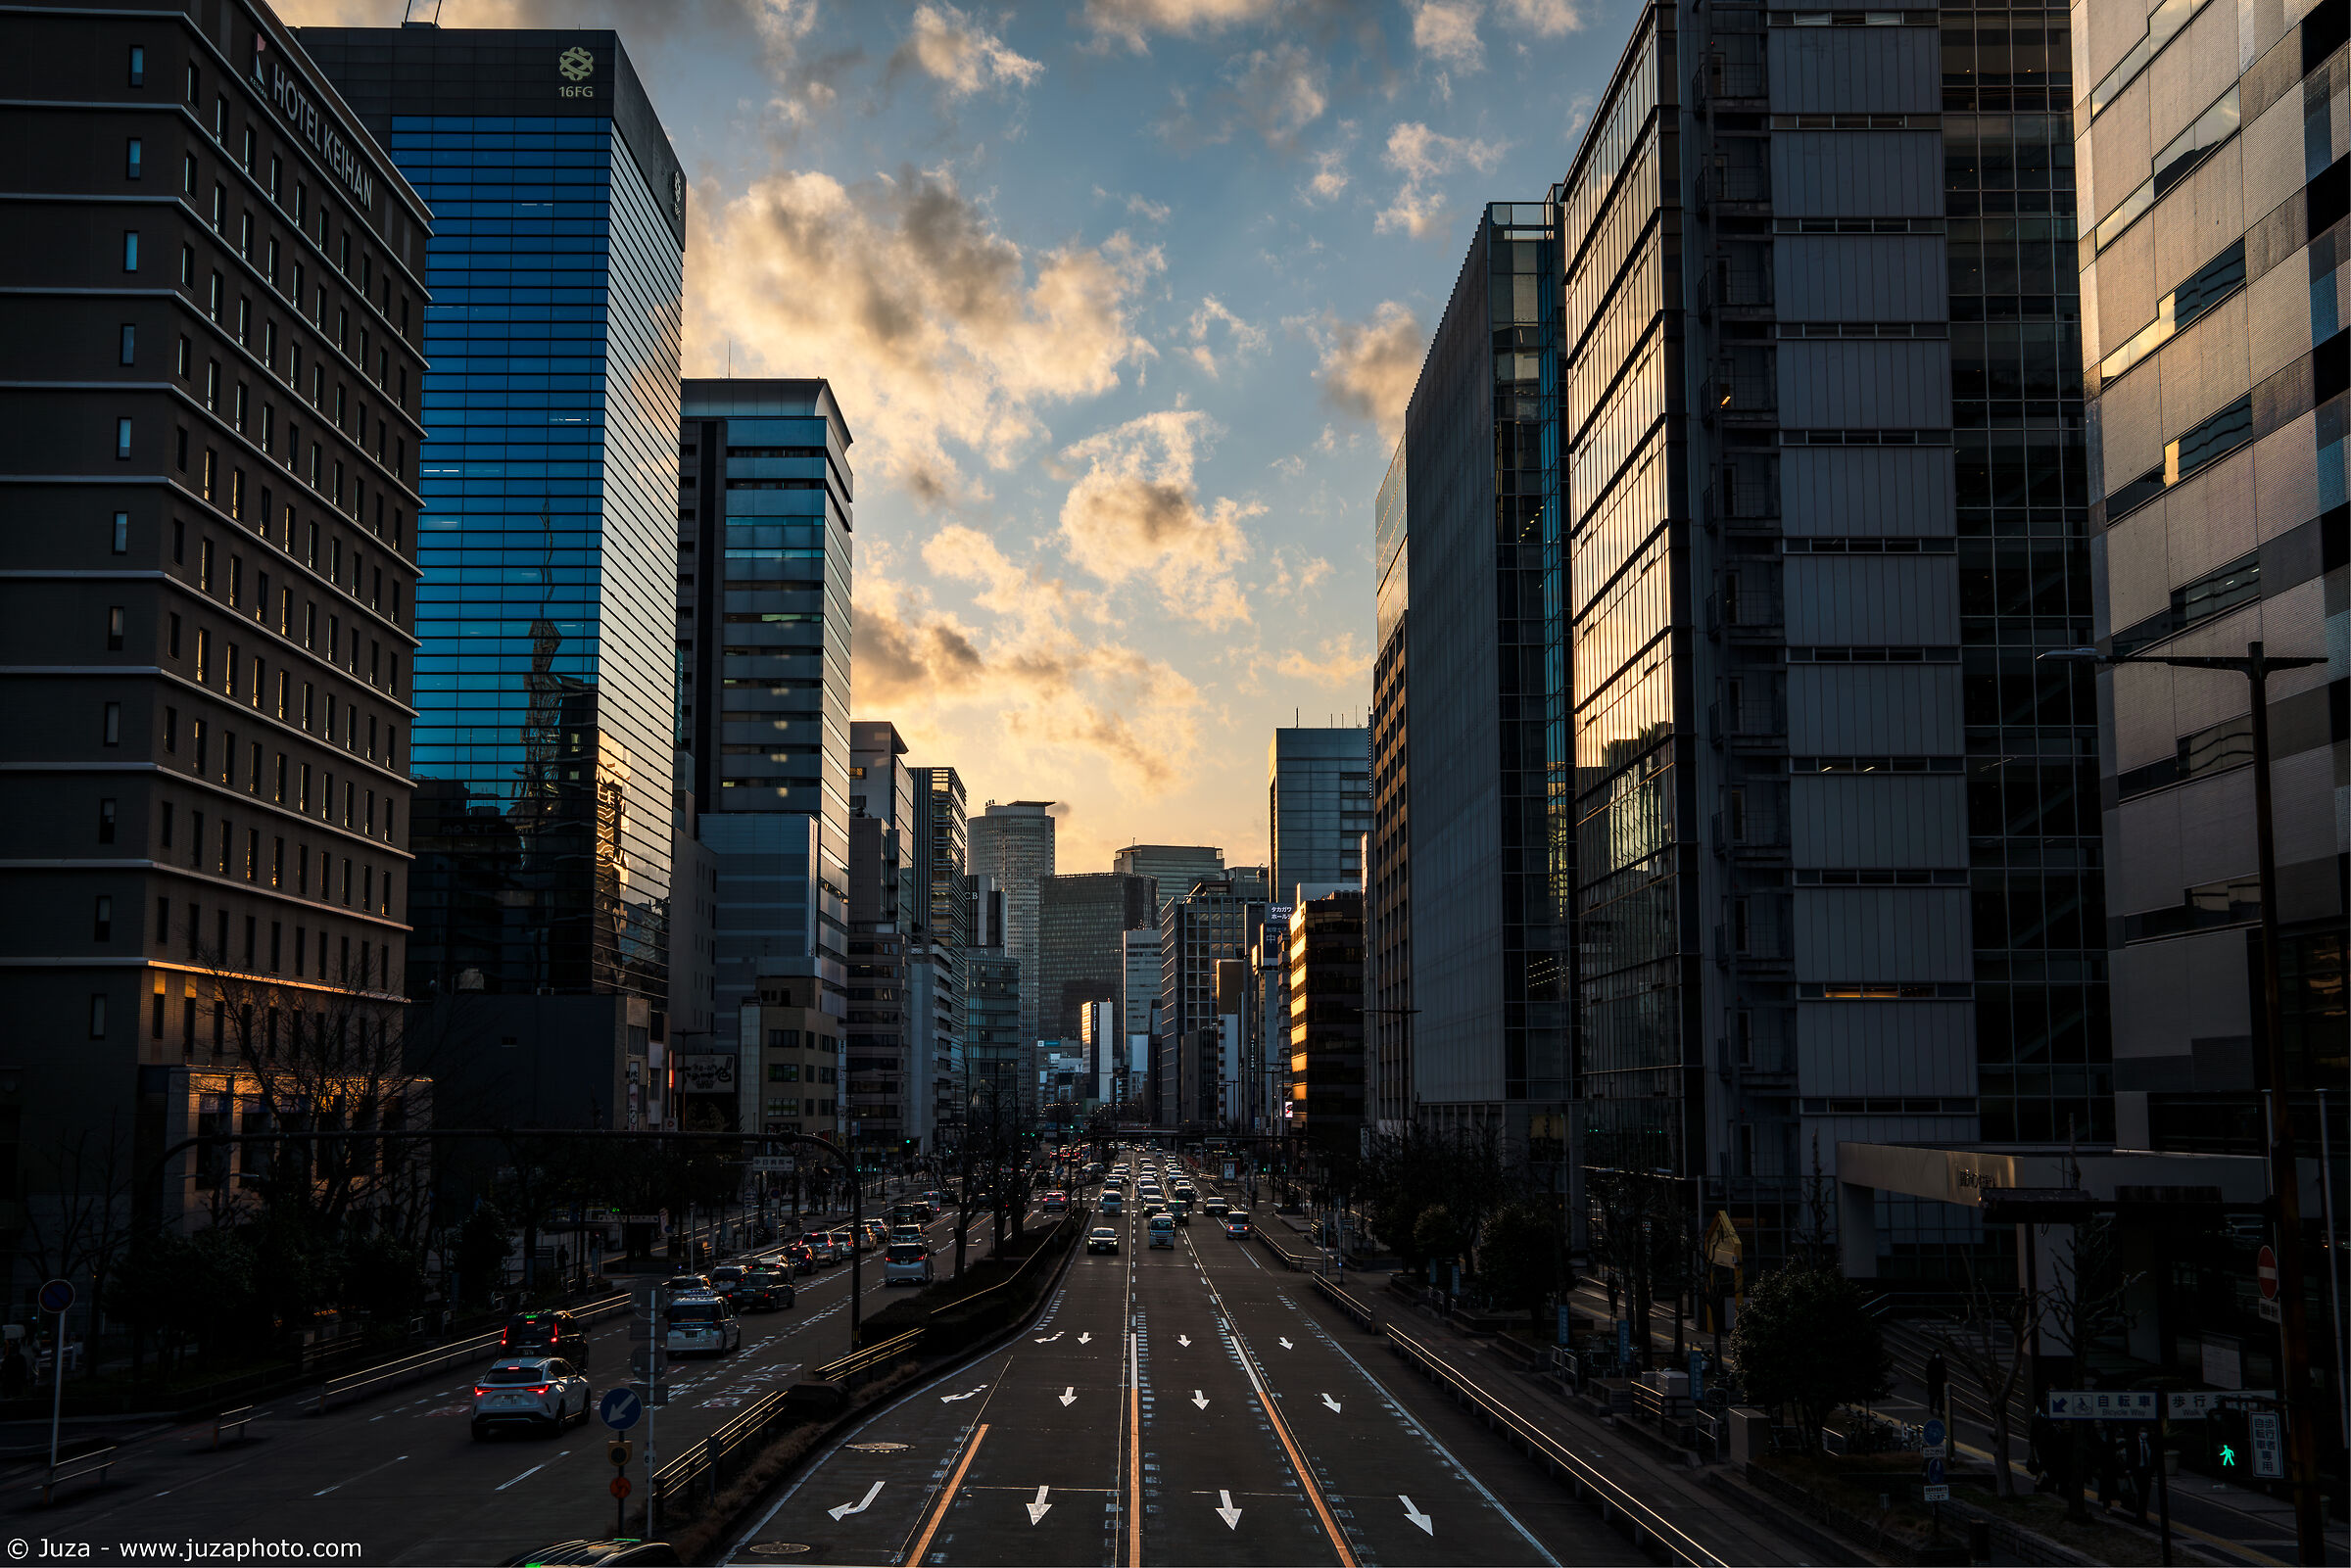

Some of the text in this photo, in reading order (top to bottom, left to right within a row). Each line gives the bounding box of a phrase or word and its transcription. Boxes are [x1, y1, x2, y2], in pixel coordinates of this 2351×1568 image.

[558, 85, 594, 98] 16FG
[273, 63, 372, 213] HOTEL KEIHAN
[2097, 1395, 2151, 1407] 自転車
[2101, 1408, 2146, 1417] Bicycle Way
